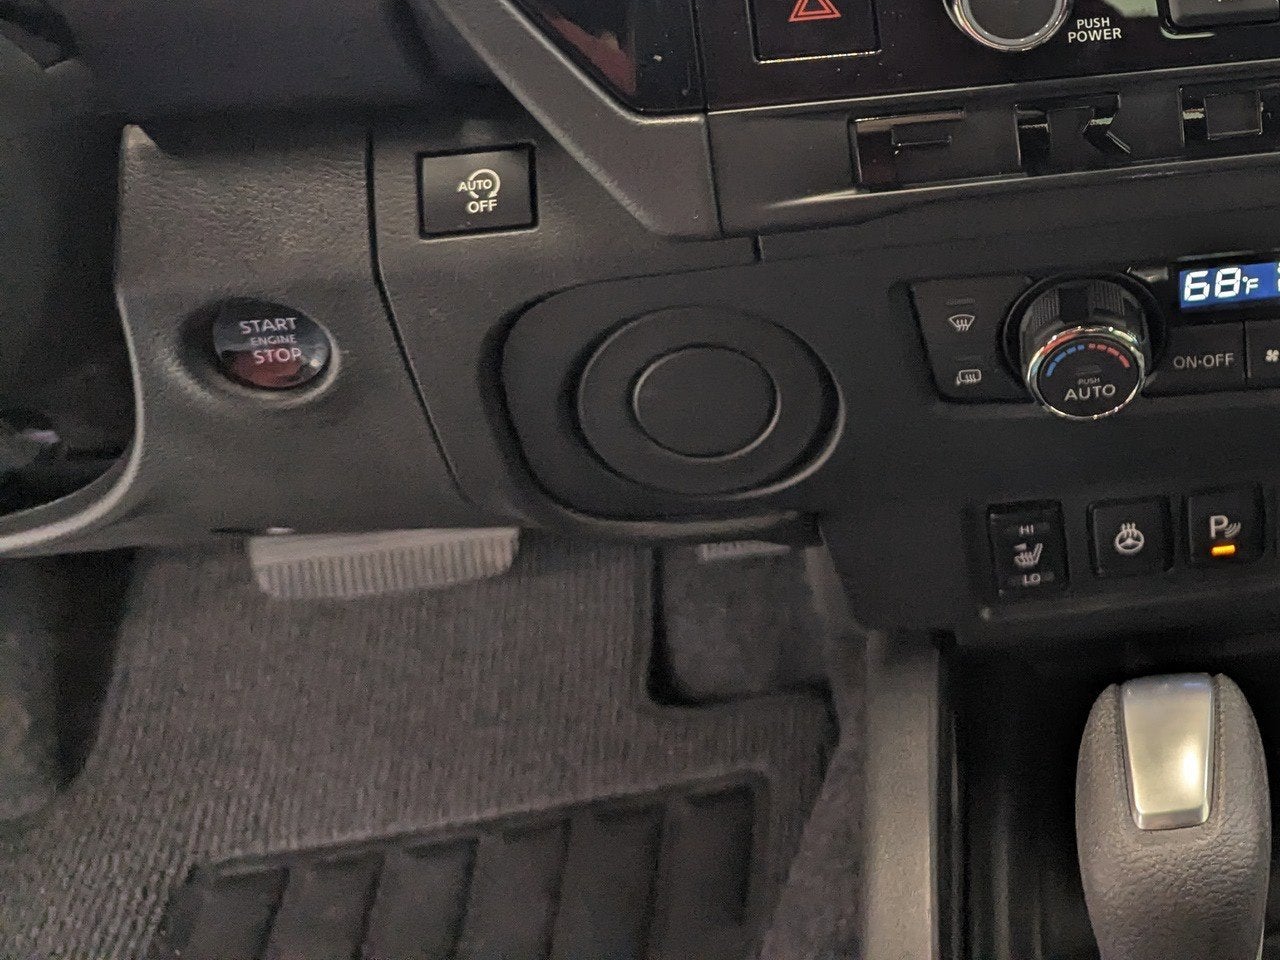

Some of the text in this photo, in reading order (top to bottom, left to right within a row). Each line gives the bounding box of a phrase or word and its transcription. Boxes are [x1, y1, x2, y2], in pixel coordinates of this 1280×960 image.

[1075, 16, 1111, 30] PUSH
[1067, 28, 1122, 45] POWER
[456, 178, 494, 194] AUTO
[466, 198, 499, 215] OFF
[239, 316, 298, 335] START
[252, 346, 303, 364] STOP
[1063, 383, 1116, 402] AUTO
[1018, 524, 1035, 536] HI
[1022, 573, 1041, 586] LO
